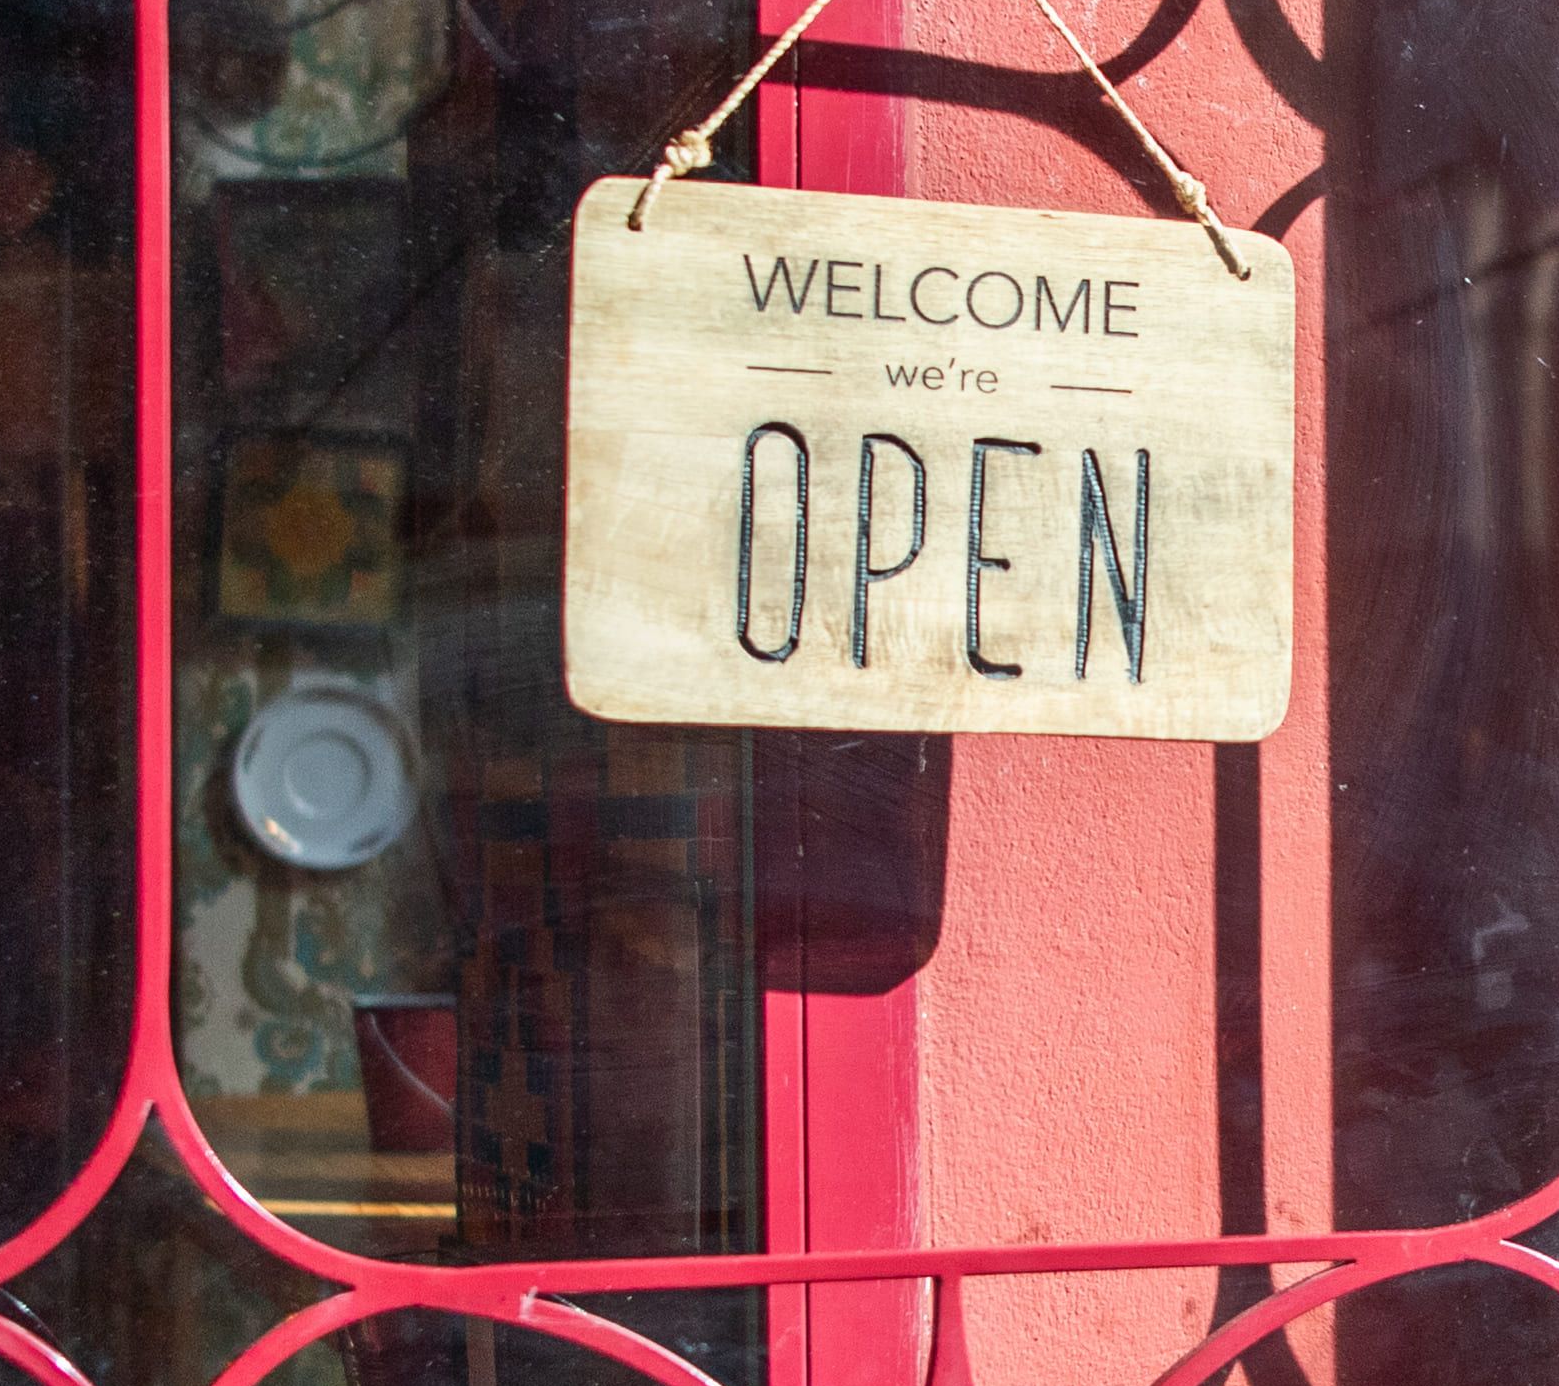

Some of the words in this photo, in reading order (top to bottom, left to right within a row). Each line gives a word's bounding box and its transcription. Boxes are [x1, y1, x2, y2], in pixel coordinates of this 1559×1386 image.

[742, 252, 1140, 339] WELCOME
[884, 356, 1000, 395] we're
[736, 420, 1152, 684] OPEN
